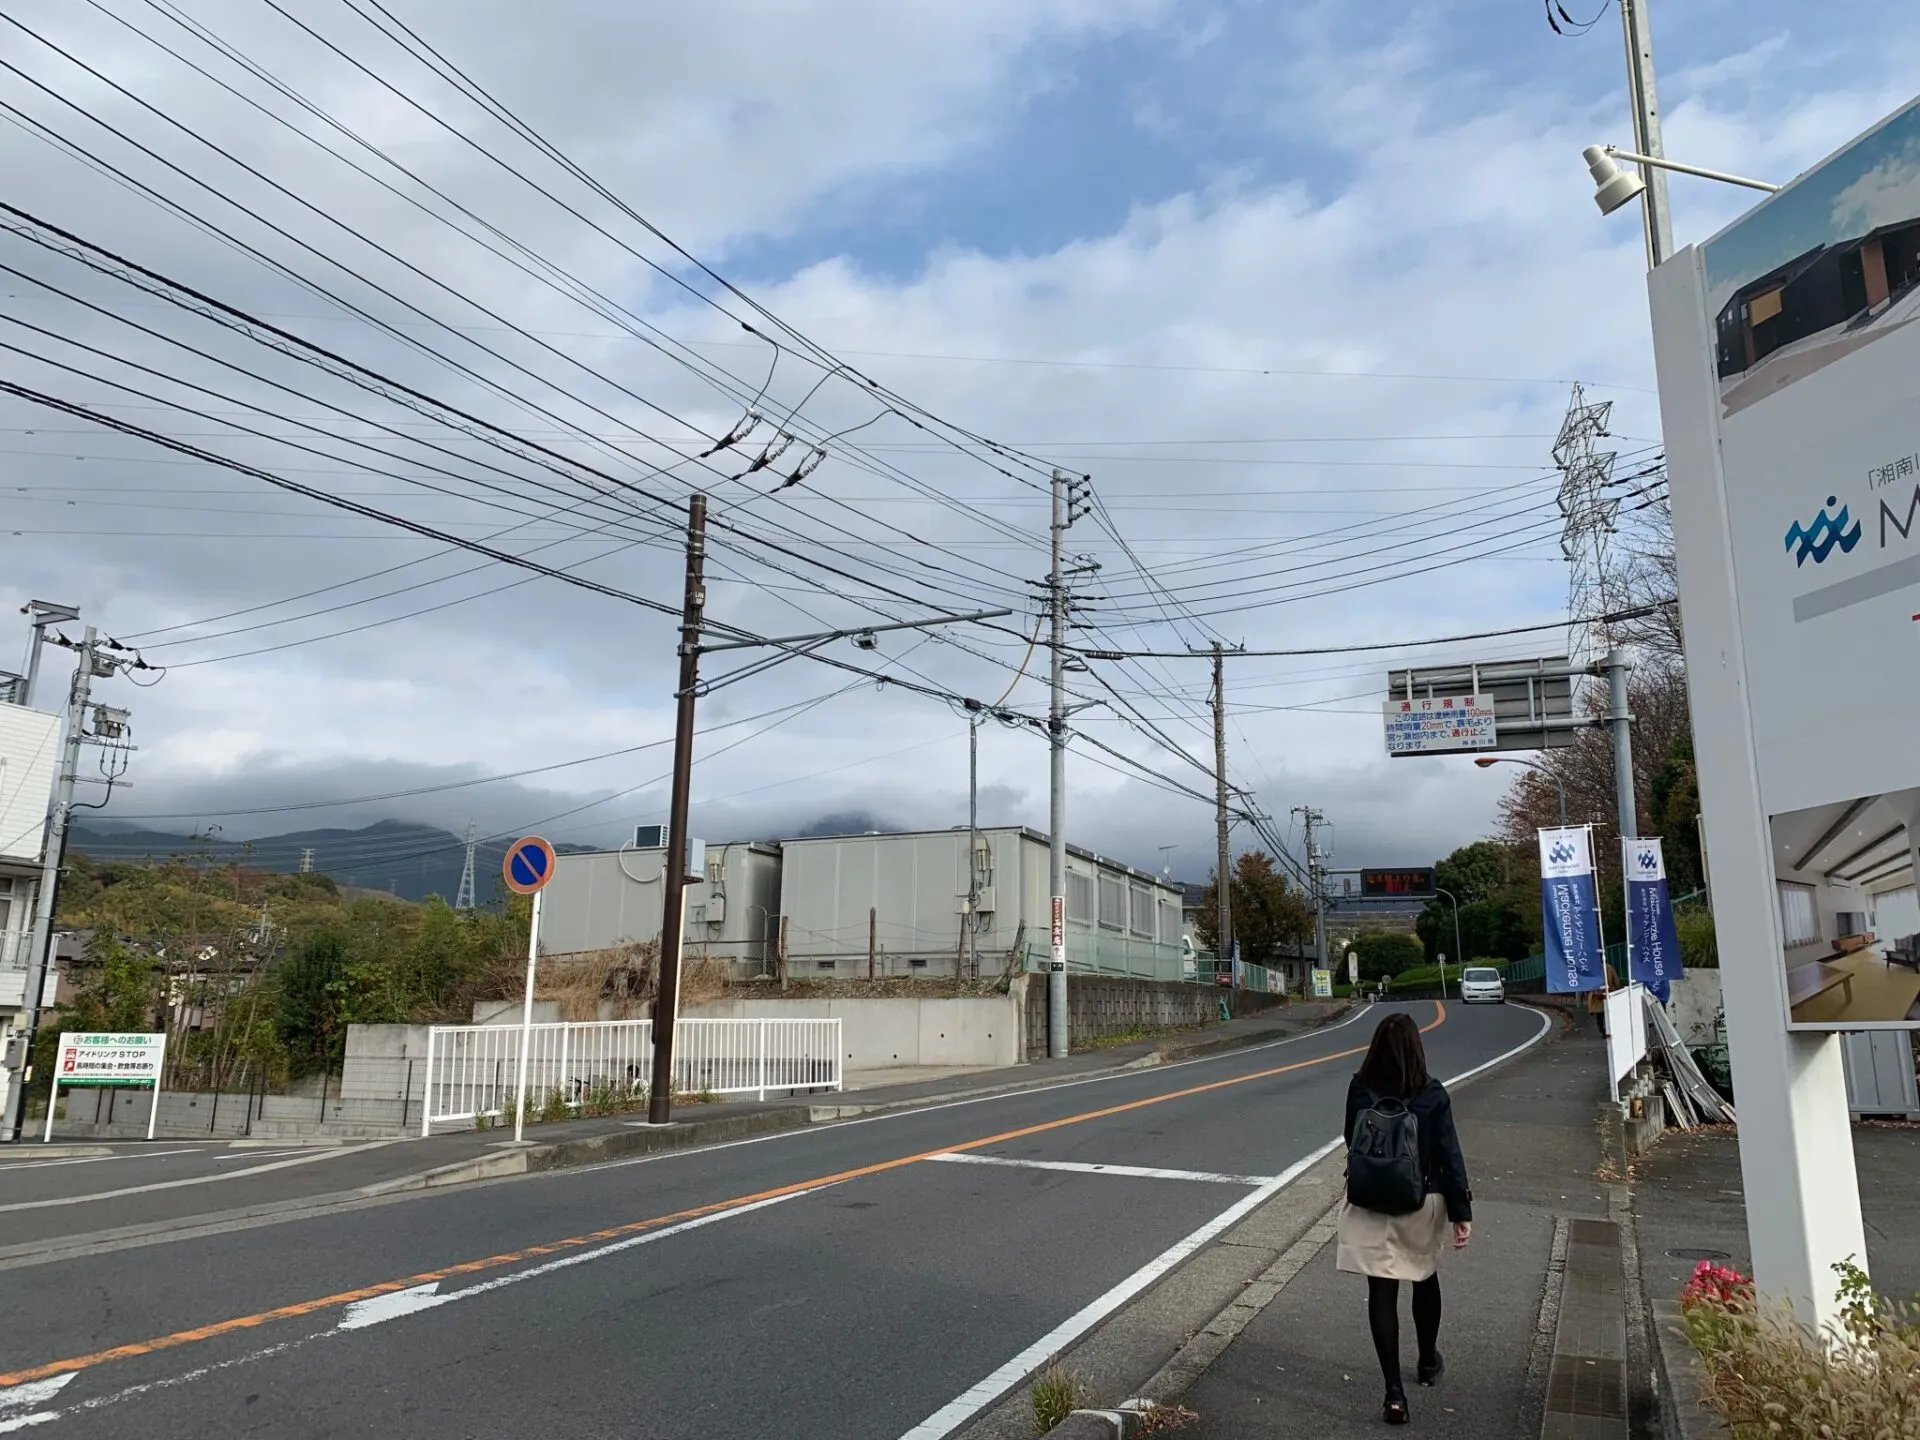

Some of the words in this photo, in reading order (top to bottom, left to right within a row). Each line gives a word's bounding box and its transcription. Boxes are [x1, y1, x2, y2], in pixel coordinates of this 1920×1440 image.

[1868, 453, 1920, 490] 「湘南
[1401, 698, 1474, 711] 通行規制
[1653, 941, 1664, 976] House
[83, 1035, 152, 1045] お客様へのお願い
